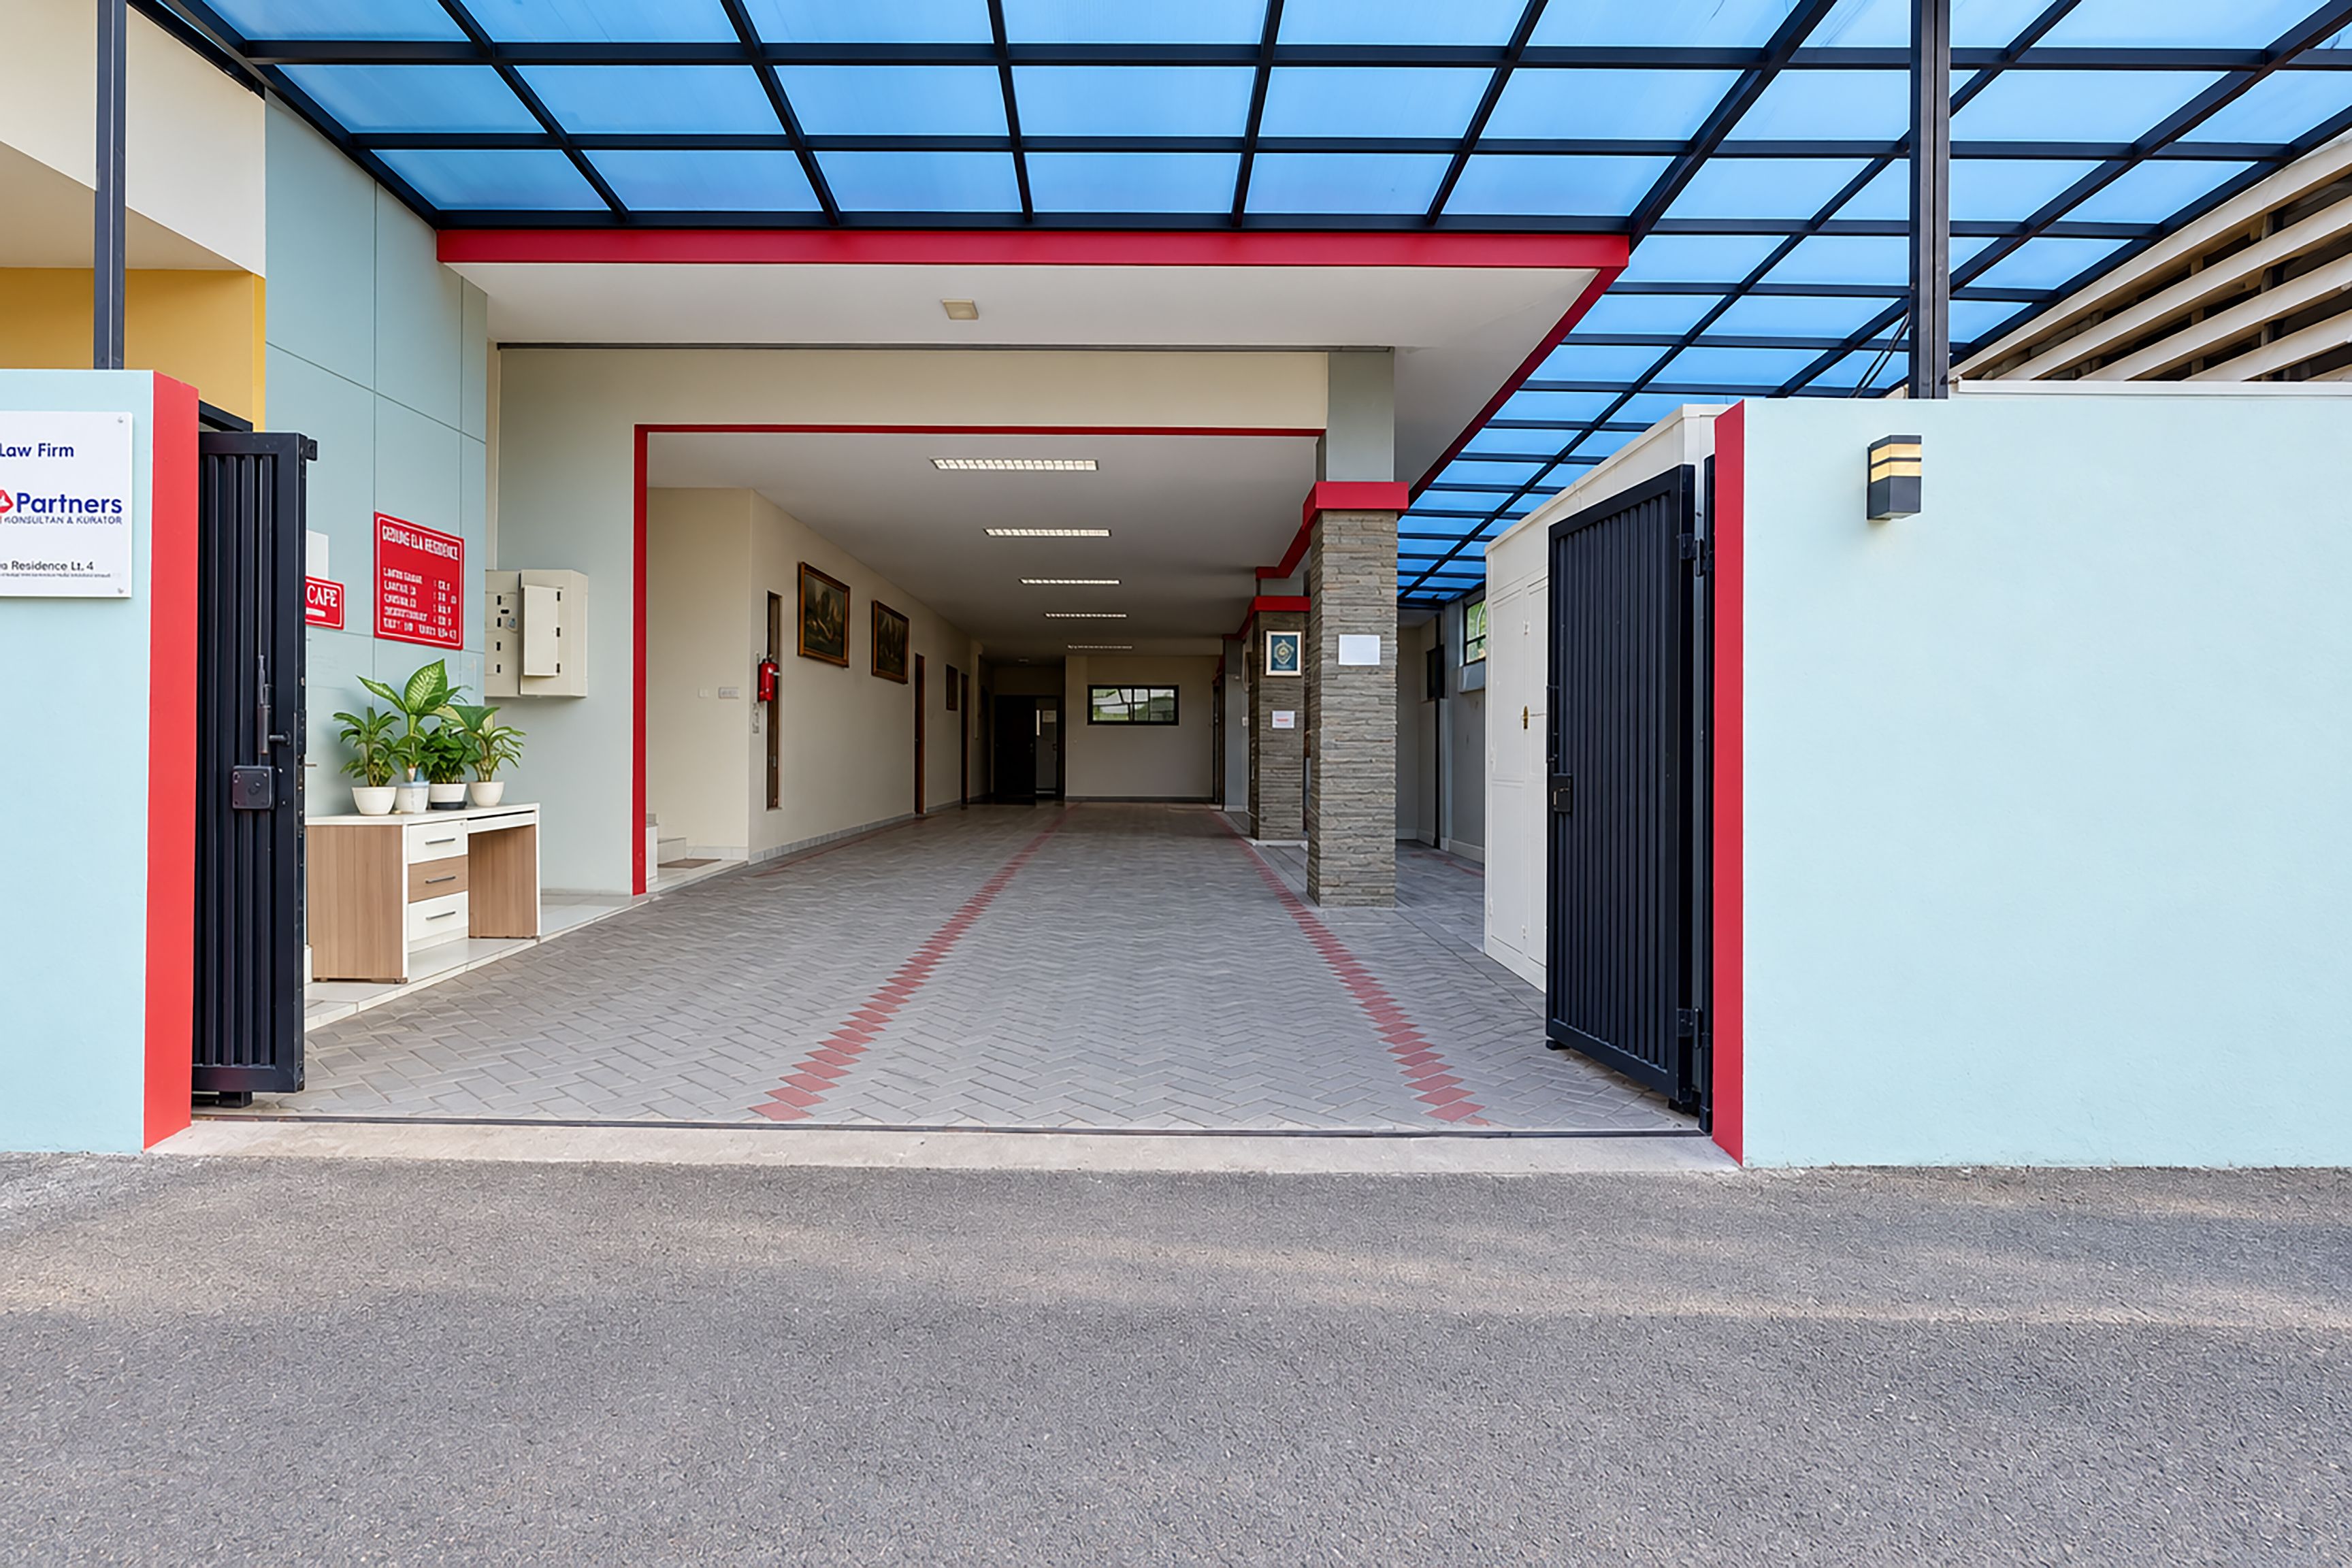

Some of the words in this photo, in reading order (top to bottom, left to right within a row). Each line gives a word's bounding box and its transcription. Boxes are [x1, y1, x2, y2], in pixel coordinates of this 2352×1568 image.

[0, 443, 32, 457] Law
[37, 443, 74, 457] Firm
[16, 492, 122, 514] Partners
[76, 515, 122, 524] KURATOR
[12, 561, 67, 571] Residence
[86, 561, 94, 570] 4
[307, 585, 338, 608] CAFE
